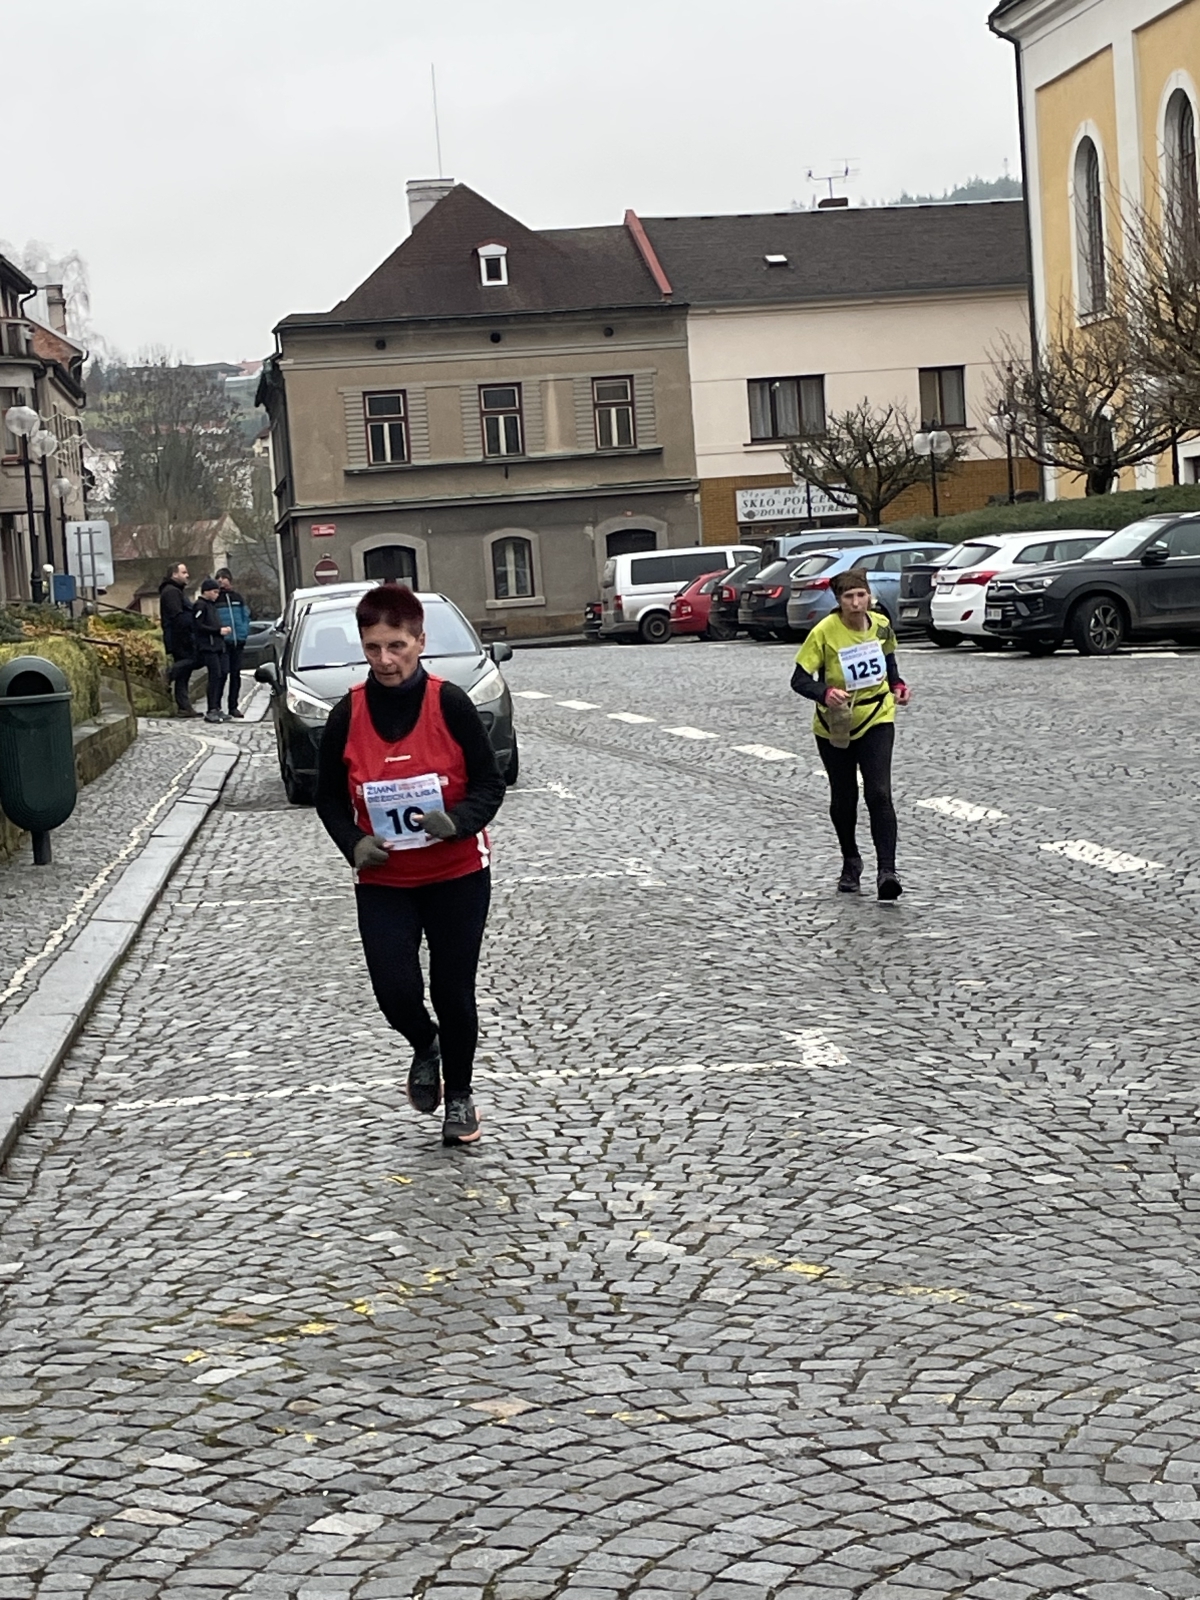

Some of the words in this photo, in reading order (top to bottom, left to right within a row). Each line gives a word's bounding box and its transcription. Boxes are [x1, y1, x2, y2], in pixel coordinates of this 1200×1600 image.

[742, 497, 775, 508] SKLO
[848, 658, 881, 680] 125
[415, 788, 439, 798] LIGA
